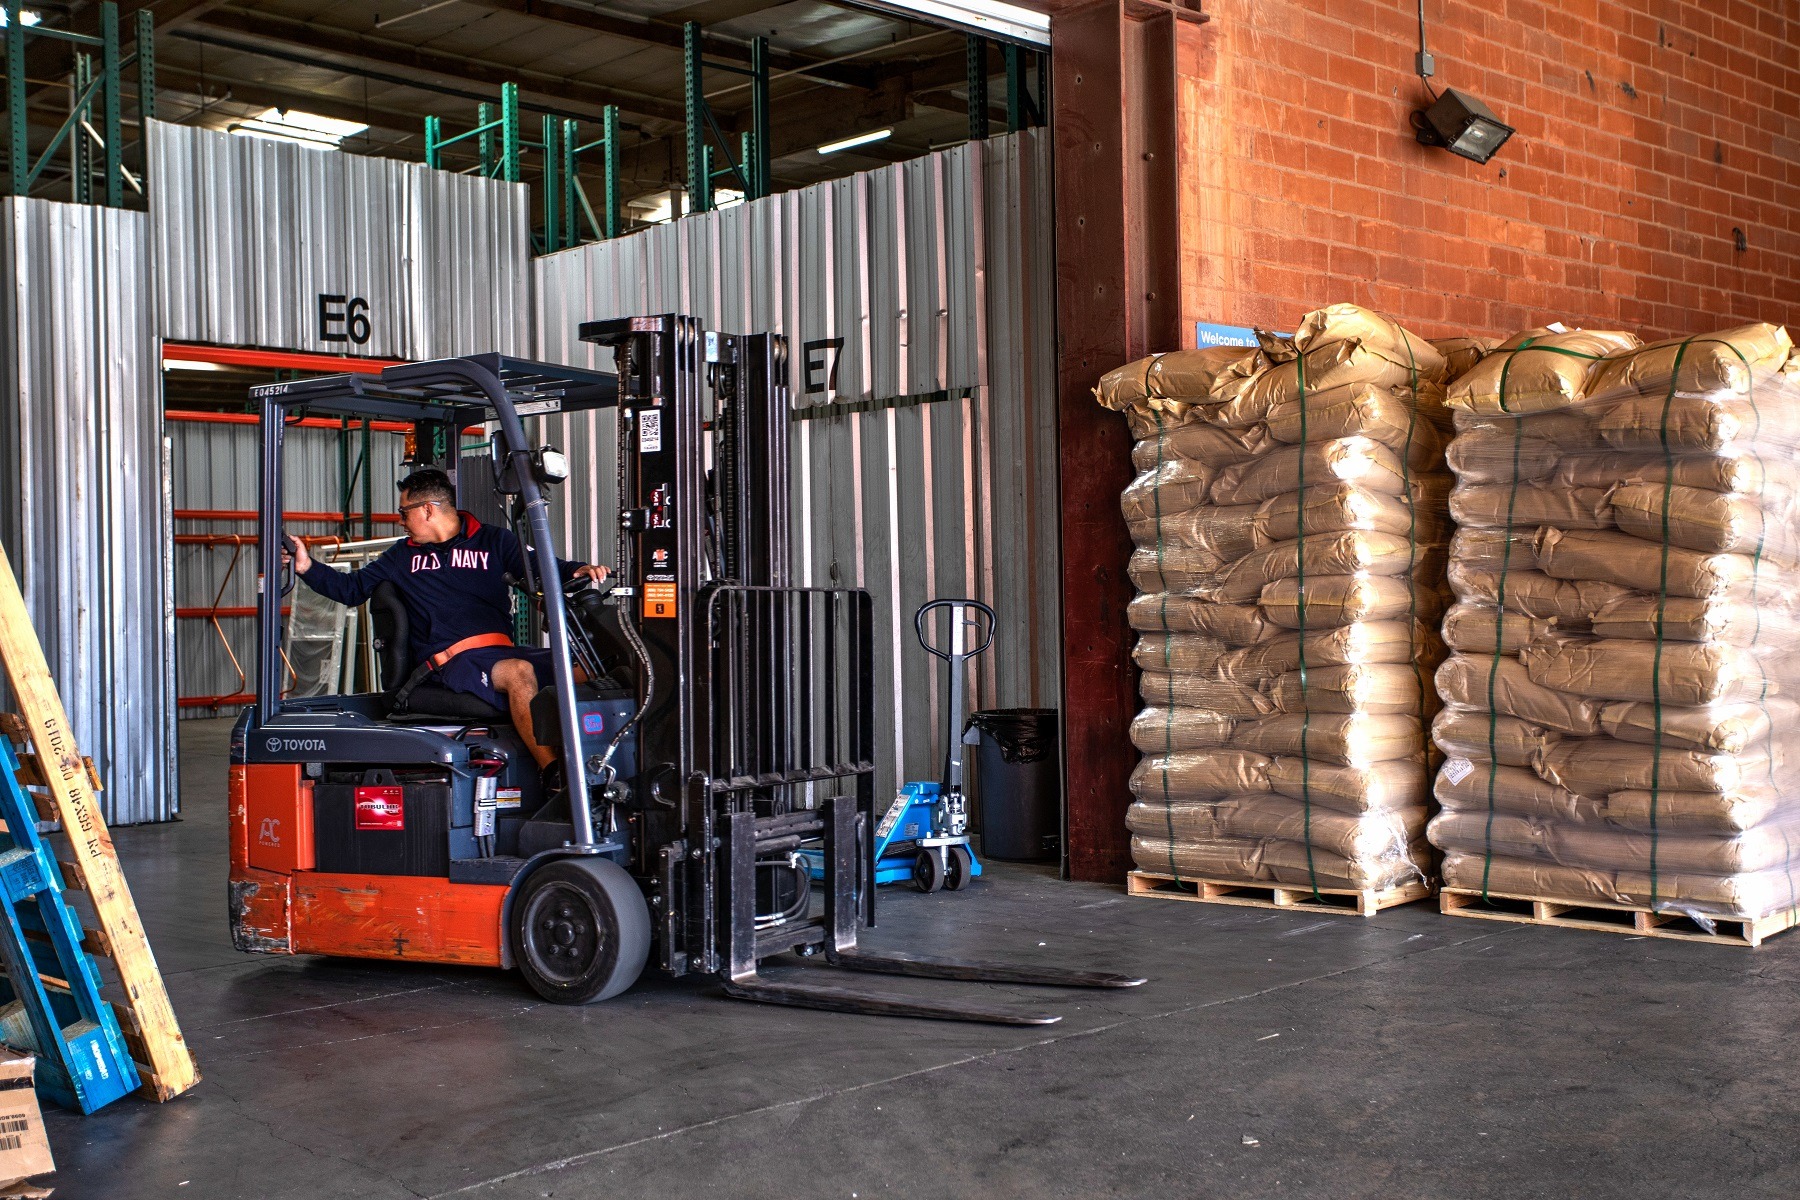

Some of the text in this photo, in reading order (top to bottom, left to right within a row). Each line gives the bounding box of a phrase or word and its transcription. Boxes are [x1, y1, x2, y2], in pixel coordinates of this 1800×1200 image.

[318, 293, 371, 345] E6
[1200, 330, 1256, 347] Welcome to
[803, 336, 845, 394] E7
[254, 384, 289, 398] E045214
[411, 548, 489, 573] OLD NAVY
[283, 739, 326, 751] TOYOTA
